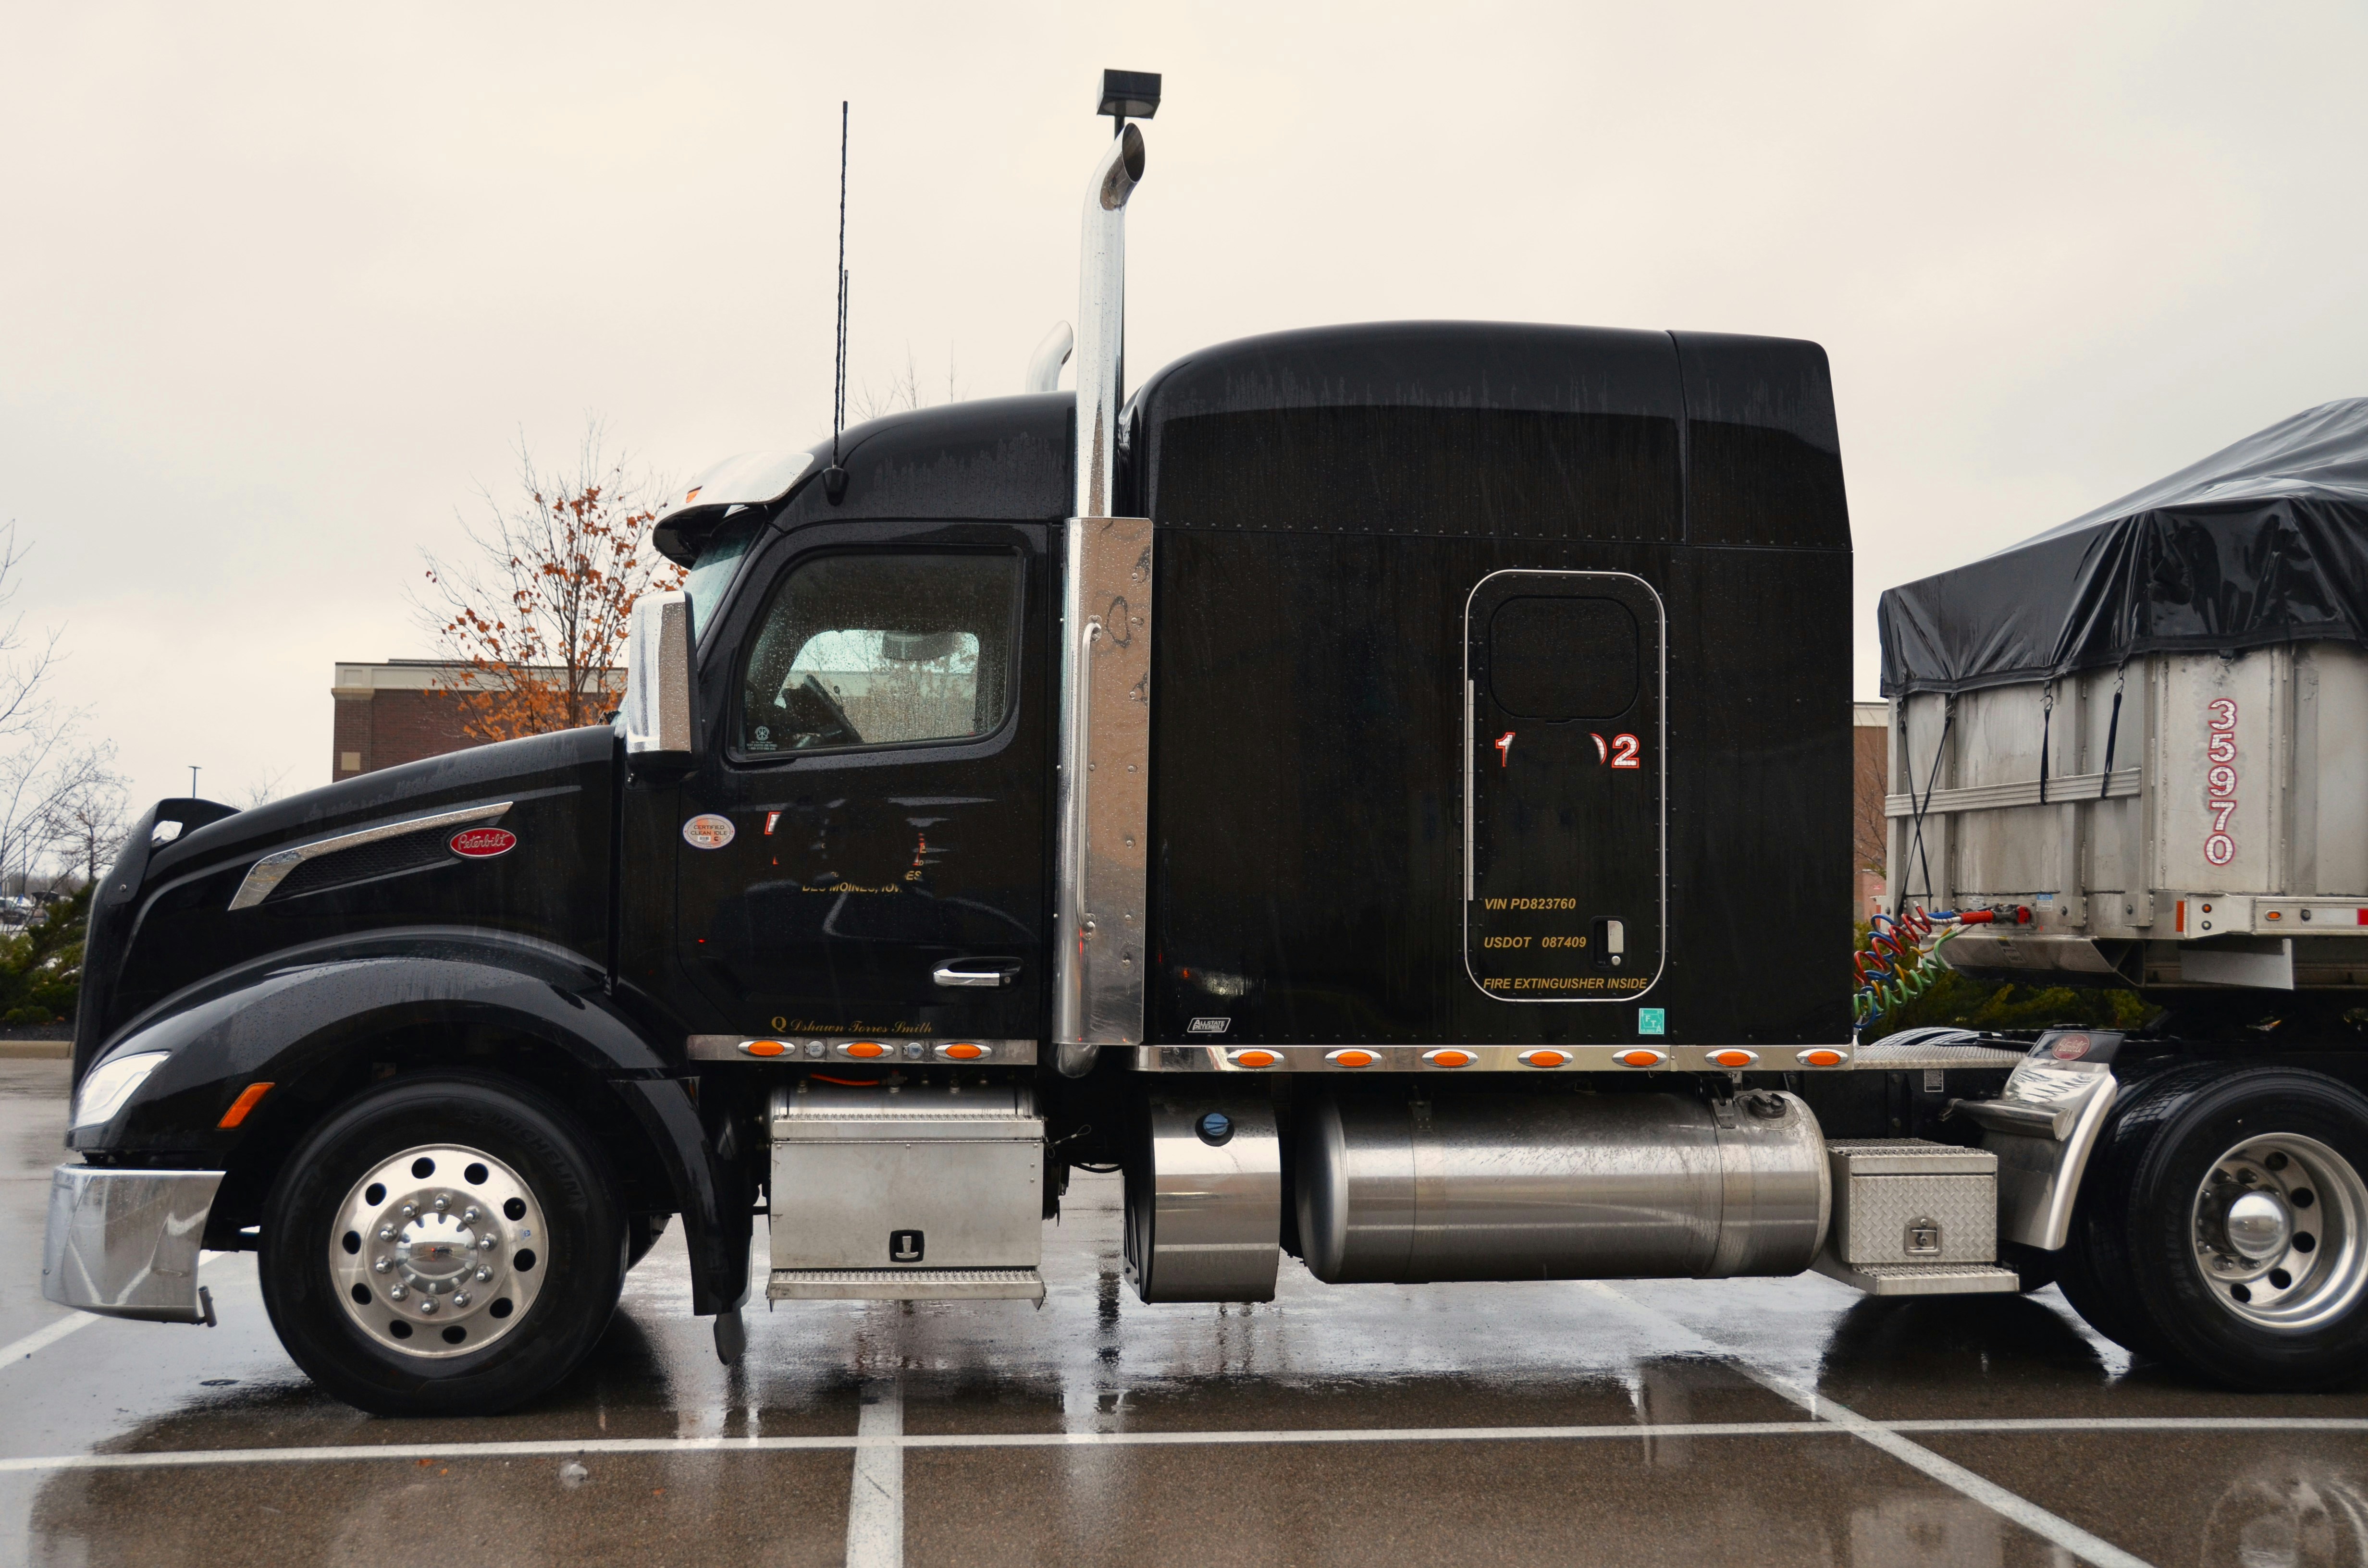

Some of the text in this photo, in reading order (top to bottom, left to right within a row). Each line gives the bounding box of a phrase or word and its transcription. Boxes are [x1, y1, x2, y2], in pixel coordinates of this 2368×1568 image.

[2204, 698, 2237, 866] 35970
[458, 834, 510, 850] Peterbilt
[1485, 898, 1576, 909] VIN PD823760
[1484, 937, 1586, 948] USDOT 087409
[1483, 978, 1647, 989] FIRE EXTINGUISHER INSIDE
[771, 1017, 934, 1033] Q Dshawn Torres Smith
